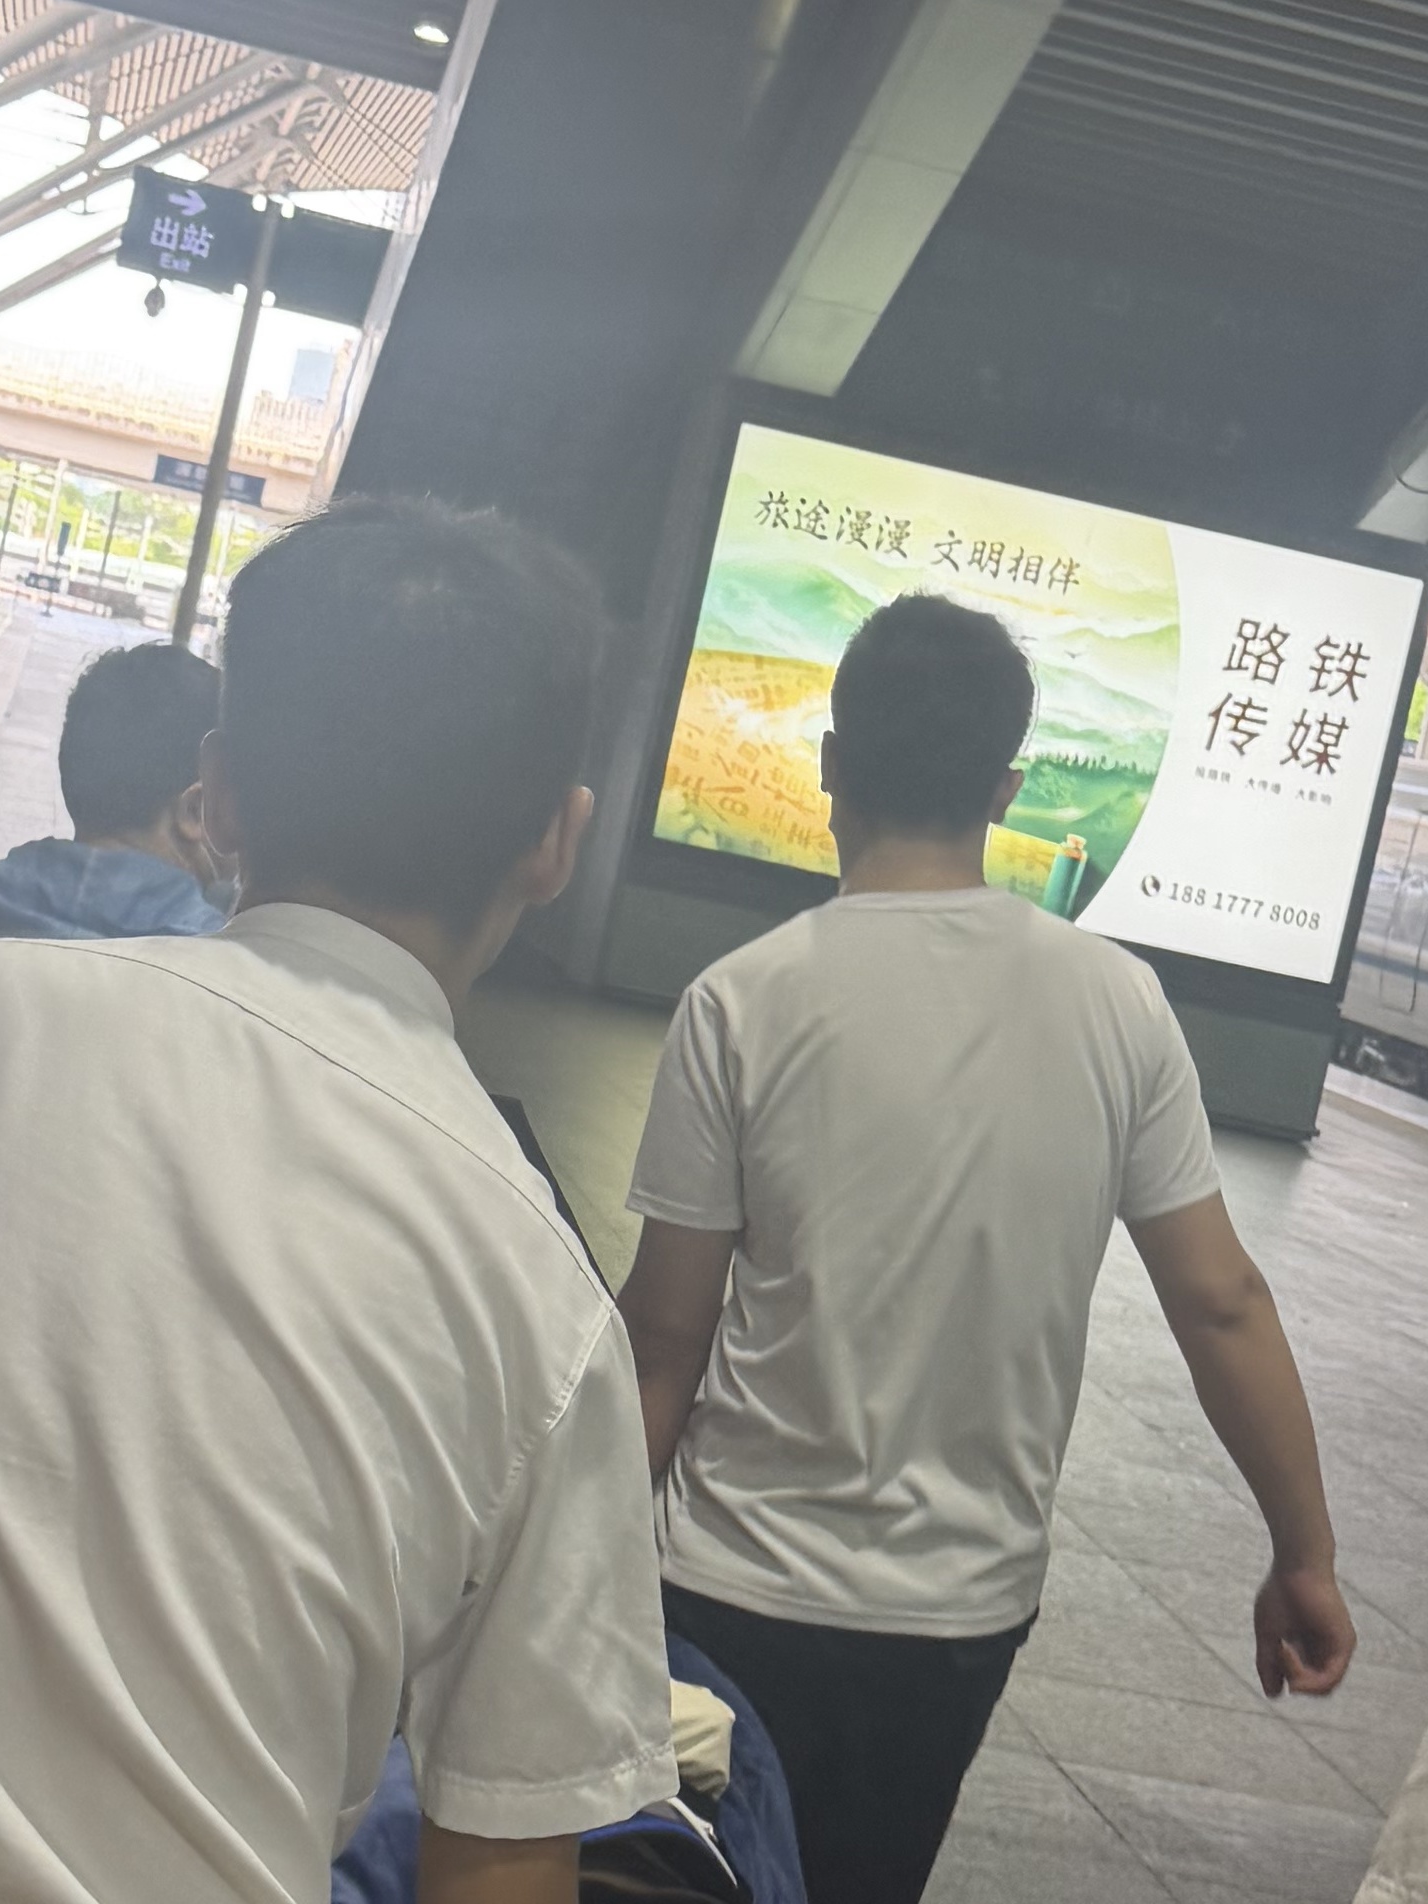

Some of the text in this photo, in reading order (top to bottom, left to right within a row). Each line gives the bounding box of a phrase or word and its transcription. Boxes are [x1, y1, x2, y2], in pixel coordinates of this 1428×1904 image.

[151, 216, 214, 258] 出站
[754, 490, 1081, 596] 旅途漫漫 文明相伴
[1168, 882, 1207, 907] 188
[1212, 891, 1265, 919] 1777
